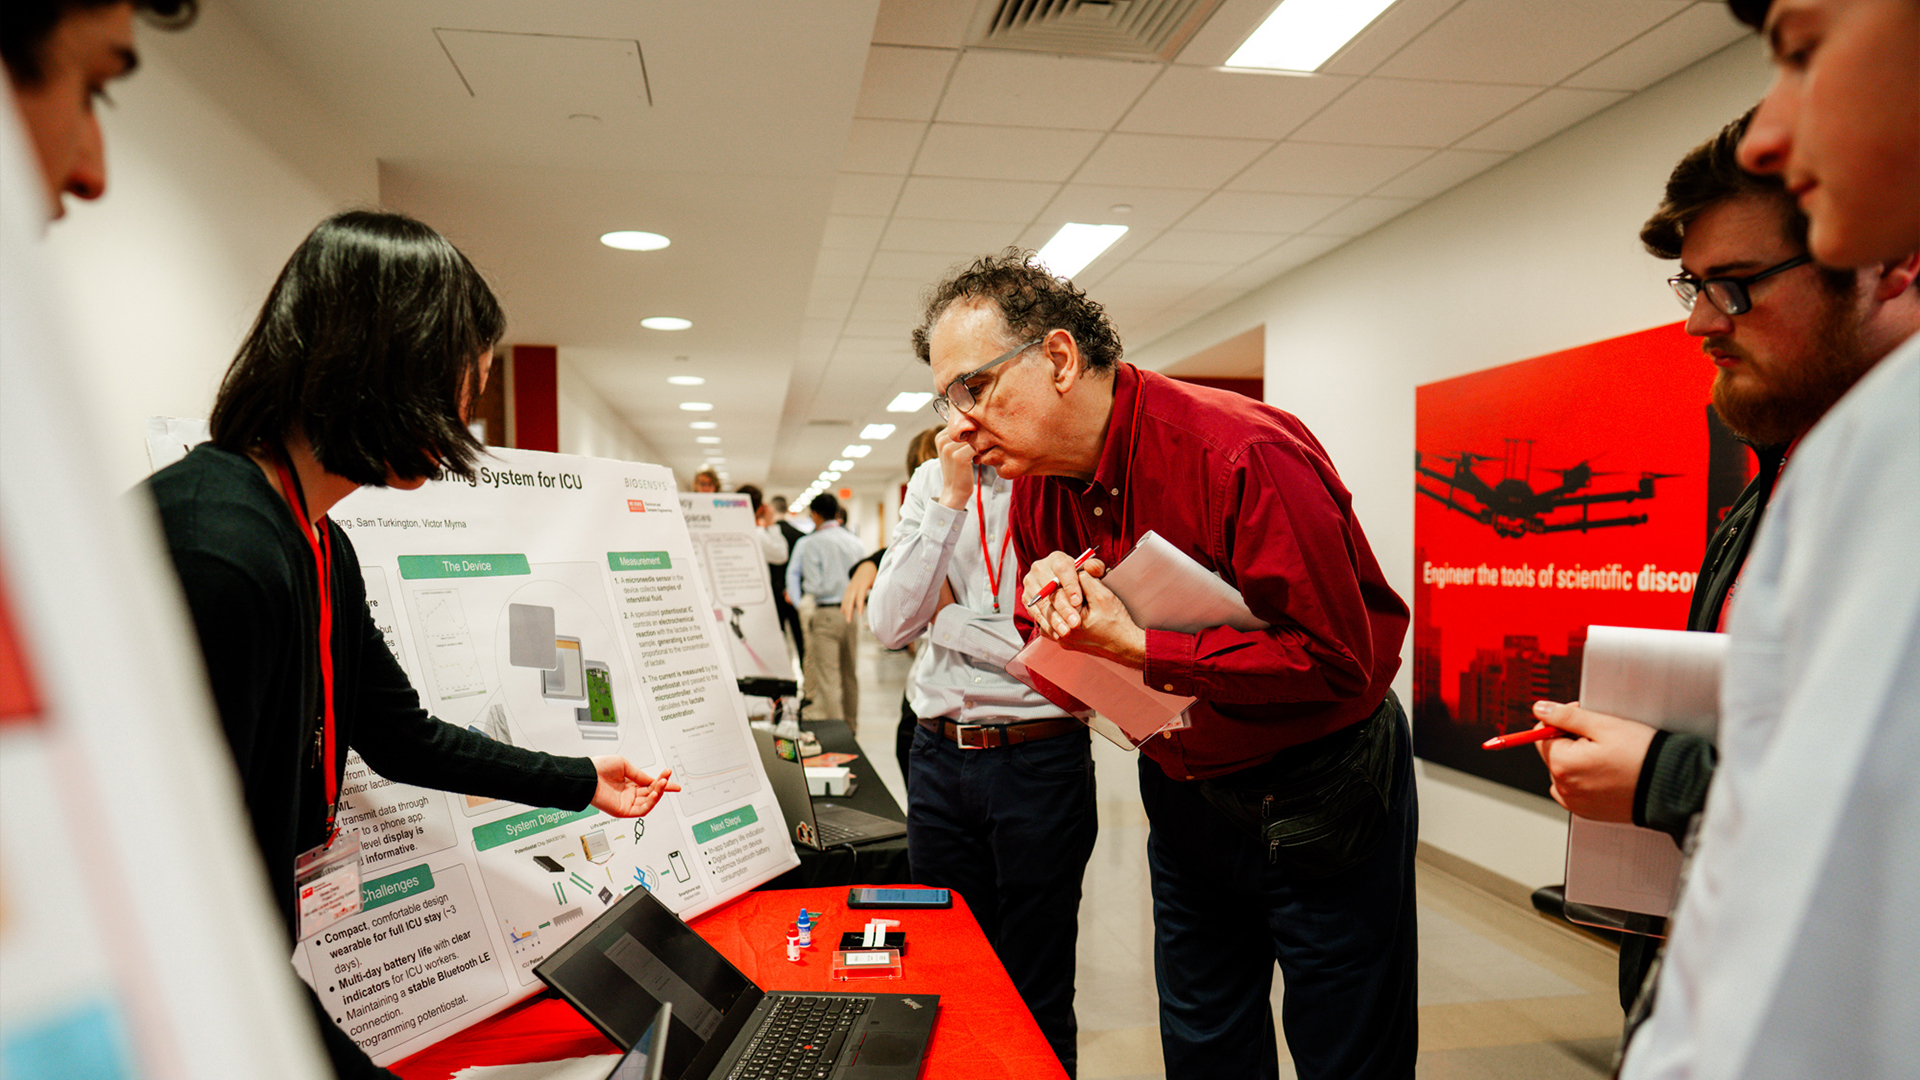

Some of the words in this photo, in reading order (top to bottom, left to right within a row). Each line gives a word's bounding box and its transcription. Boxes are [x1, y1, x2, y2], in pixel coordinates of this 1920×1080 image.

[480, 466, 534, 488] System
[538, 472, 555, 488] for
[559, 473, 582, 489] ICU
[624, 478, 667, 491] BIOSENSYS
[334, 518, 354, 529] ang,
[356, 518, 376, 527] Sam
[377, 518, 421, 529] Turkington,
[421, 519, 442, 528] Victor
[444, 519, 467, 530] Myrna
[442, 560, 460, 572] The
[462, 560, 492, 572] Device
[620, 556, 661, 566] Measurement
[1423, 561, 1476, 589] Engineer
[1477, 563, 1498, 586] the
[1500, 563, 1536, 588] tools
[1538, 564, 1554, 588] of
[1556, 564, 1632, 590] scientific
[635, 610, 660, 618] specialized
[661, 607, 688, 616] potentiostat
[659, 616, 694, 625] electrochemical
[642, 648, 668, 658] proportional
[682, 643, 709, 652] concentration
[658, 637, 682, 646] generating
[659, 672, 676, 680] current
[682, 667, 704, 676] measured
[652, 681, 680, 693] potentiostat
[690, 677, 706, 686] passed
[658, 701, 681, 712] calculates
[689, 696, 704, 705] lactate
[346, 769, 366, 780] from
[342, 810, 378, 826] transmit
[378, 806, 397, 817] data
[398, 796, 429, 811] through
[362, 827, 371, 835] to
[380, 818, 406, 832] phone
[408, 813, 426, 824] app.
[505, 819, 538, 836] System
[539, 809, 573, 825] Diagram
[710, 821, 726, 833] Next
[724, 816, 742, 827] Steps
[360, 837, 382, 850] level
[383, 830, 414, 844] display
[415, 826, 424, 835] is
[708, 844, 723, 854] In-app
[723, 838, 738, 848] battery
[745, 827, 765, 838] indication
[366, 843, 418, 864] informative.
[514, 844, 537, 854] Potentiostat
[712, 852, 726, 864] Digital
[727, 848, 742, 857] display
[749, 839, 762, 848] device
[716, 861, 736, 873] Optimize
[736, 852, 755, 864] bluetooth
[755, 846, 770, 856] battery
[721, 867, 748, 883] consumption
[361, 876, 419, 904] Challenges
[324, 922, 370, 944] Compact,
[371, 904, 421, 928] comfortable
[422, 894, 449, 909] design
[329, 937, 372, 959] wearable
[373, 931, 387, 942] for
[389, 924, 404, 937] full
[405, 917, 422, 930] ICU
[424, 911, 442, 925] stay
[443, 904, 457, 918] (~3
[334, 957, 362, 974] days).
[338, 965, 382, 990] Multi-day
[383, 952, 416, 972] battery
[417, 945, 433, 958] life
[434, 938, 450, 951] with
[451, 929, 472, 945] clear
[342, 979, 391, 1005] indicators
[392, 972, 404, 985] for
[405, 964, 423, 979] ICU
[424, 951, 459, 971] workers.
[346, 993, 399, 1021] Maintaining
[400, 989, 407, 998] a
[408, 976, 436, 995] stable
[437, 960, 478, 982] Bluetooth
[478, 952, 491, 964] LE
[417, 994, 469, 1026] potentiostat.
[350, 1007, 404, 1036] connection.
